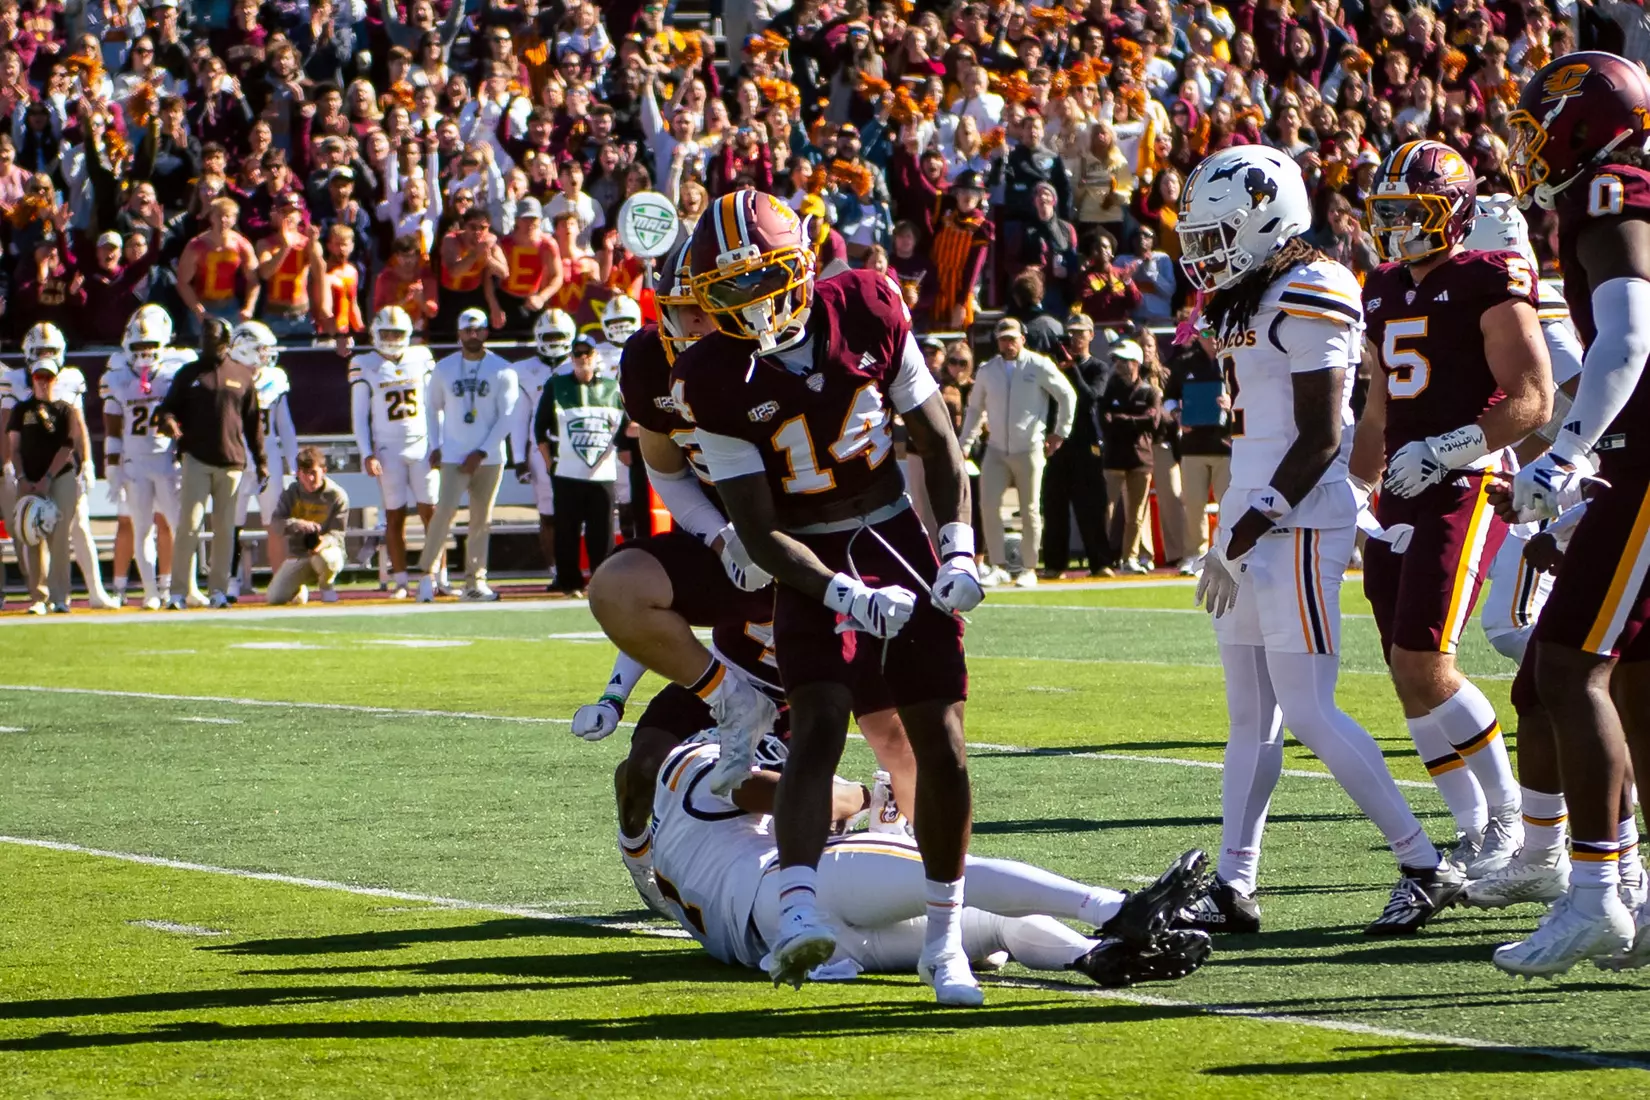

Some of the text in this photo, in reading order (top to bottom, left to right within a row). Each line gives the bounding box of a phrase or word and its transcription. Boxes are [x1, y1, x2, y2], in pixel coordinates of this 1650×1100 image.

[1587, 173, 1624, 217] 0
[633, 213, 672, 234] MAC
[204, 251, 241, 300] C
[508, 247, 539, 291] E
[1504, 257, 1532, 297] 5
[1382, 316, 1431, 400] 5
[385, 388, 417, 421] 25
[752, 401, 776, 421] 125
[770, 379, 892, 495] 14
[1439, 432, 1483, 453] Matthew
